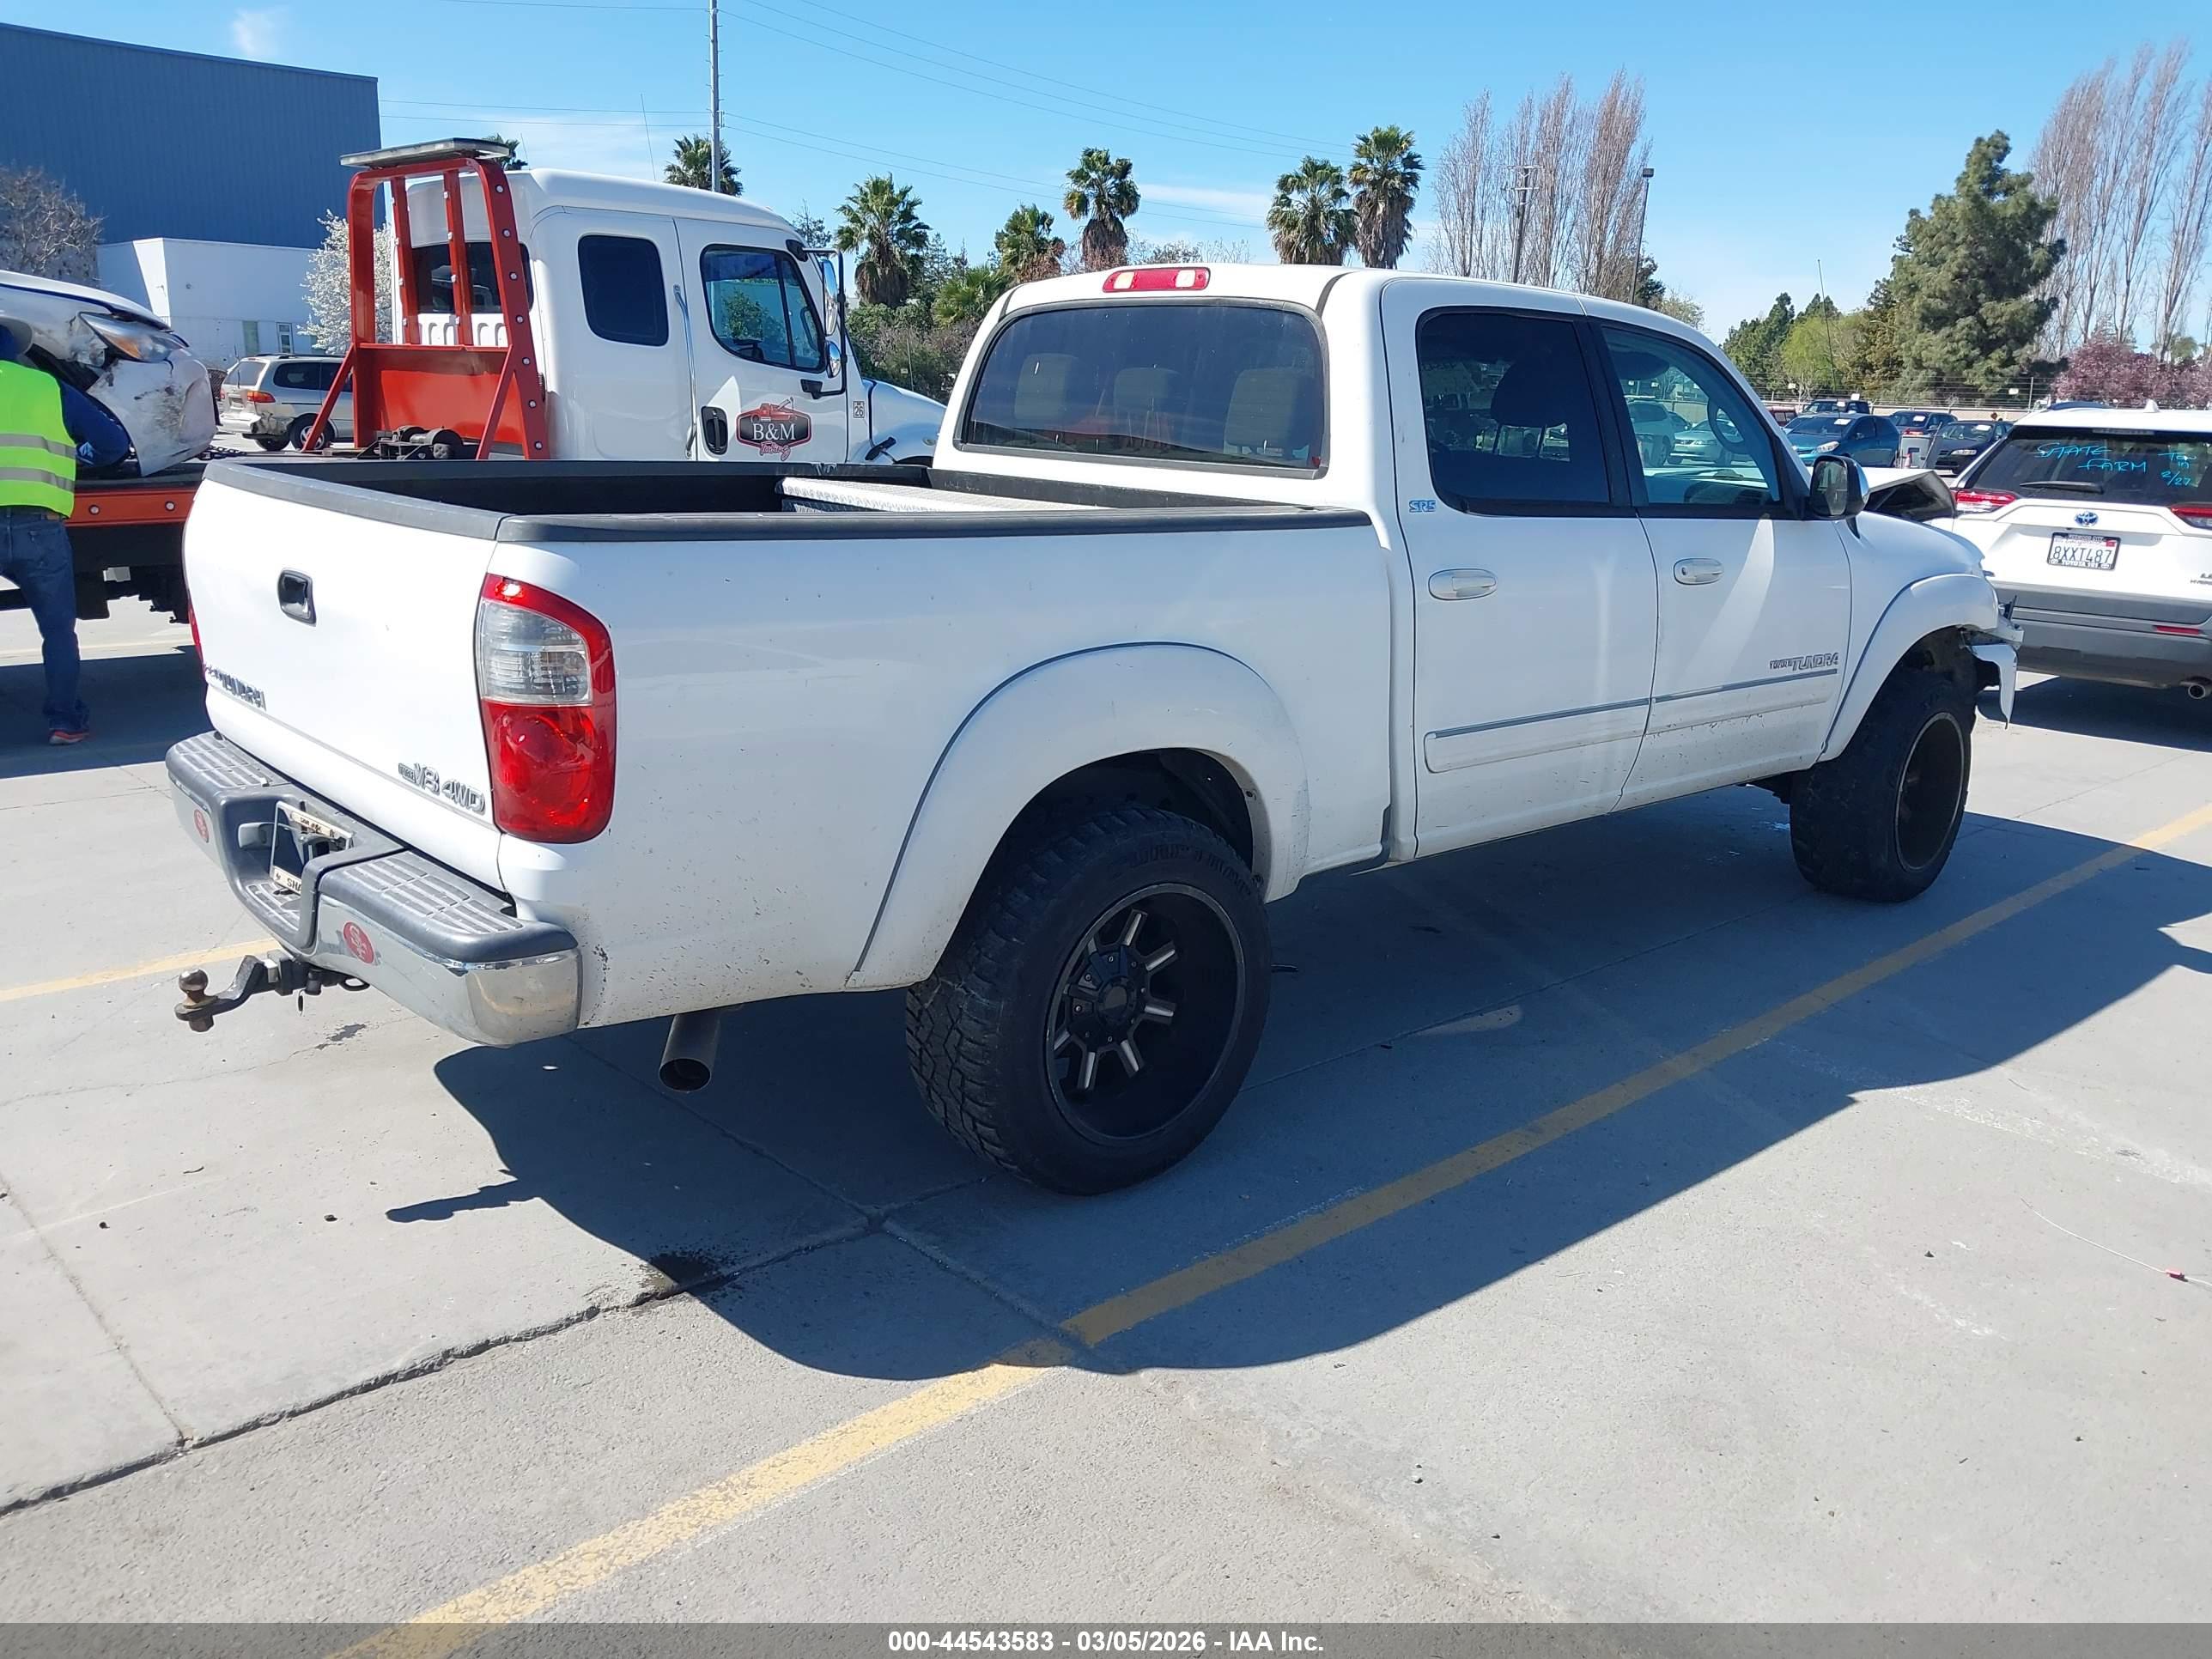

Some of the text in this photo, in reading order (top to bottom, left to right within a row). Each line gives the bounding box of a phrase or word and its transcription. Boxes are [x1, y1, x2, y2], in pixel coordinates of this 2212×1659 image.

[854, 405, 864, 417] 26
[753, 423, 796, 441] B&M
[2034, 442, 2112, 459] STATE
[2078, 458, 2147, 472] FARM
[2160, 471, 2191, 486] 2/27
[1408, 500, 1437, 513] SR5
[2053, 545, 2112, 564] 8XXT487
[1791, 652, 1839, 672] TUNDRA
[413, 763, 440, 795] V8
[441, 779, 485, 815] 4WD
